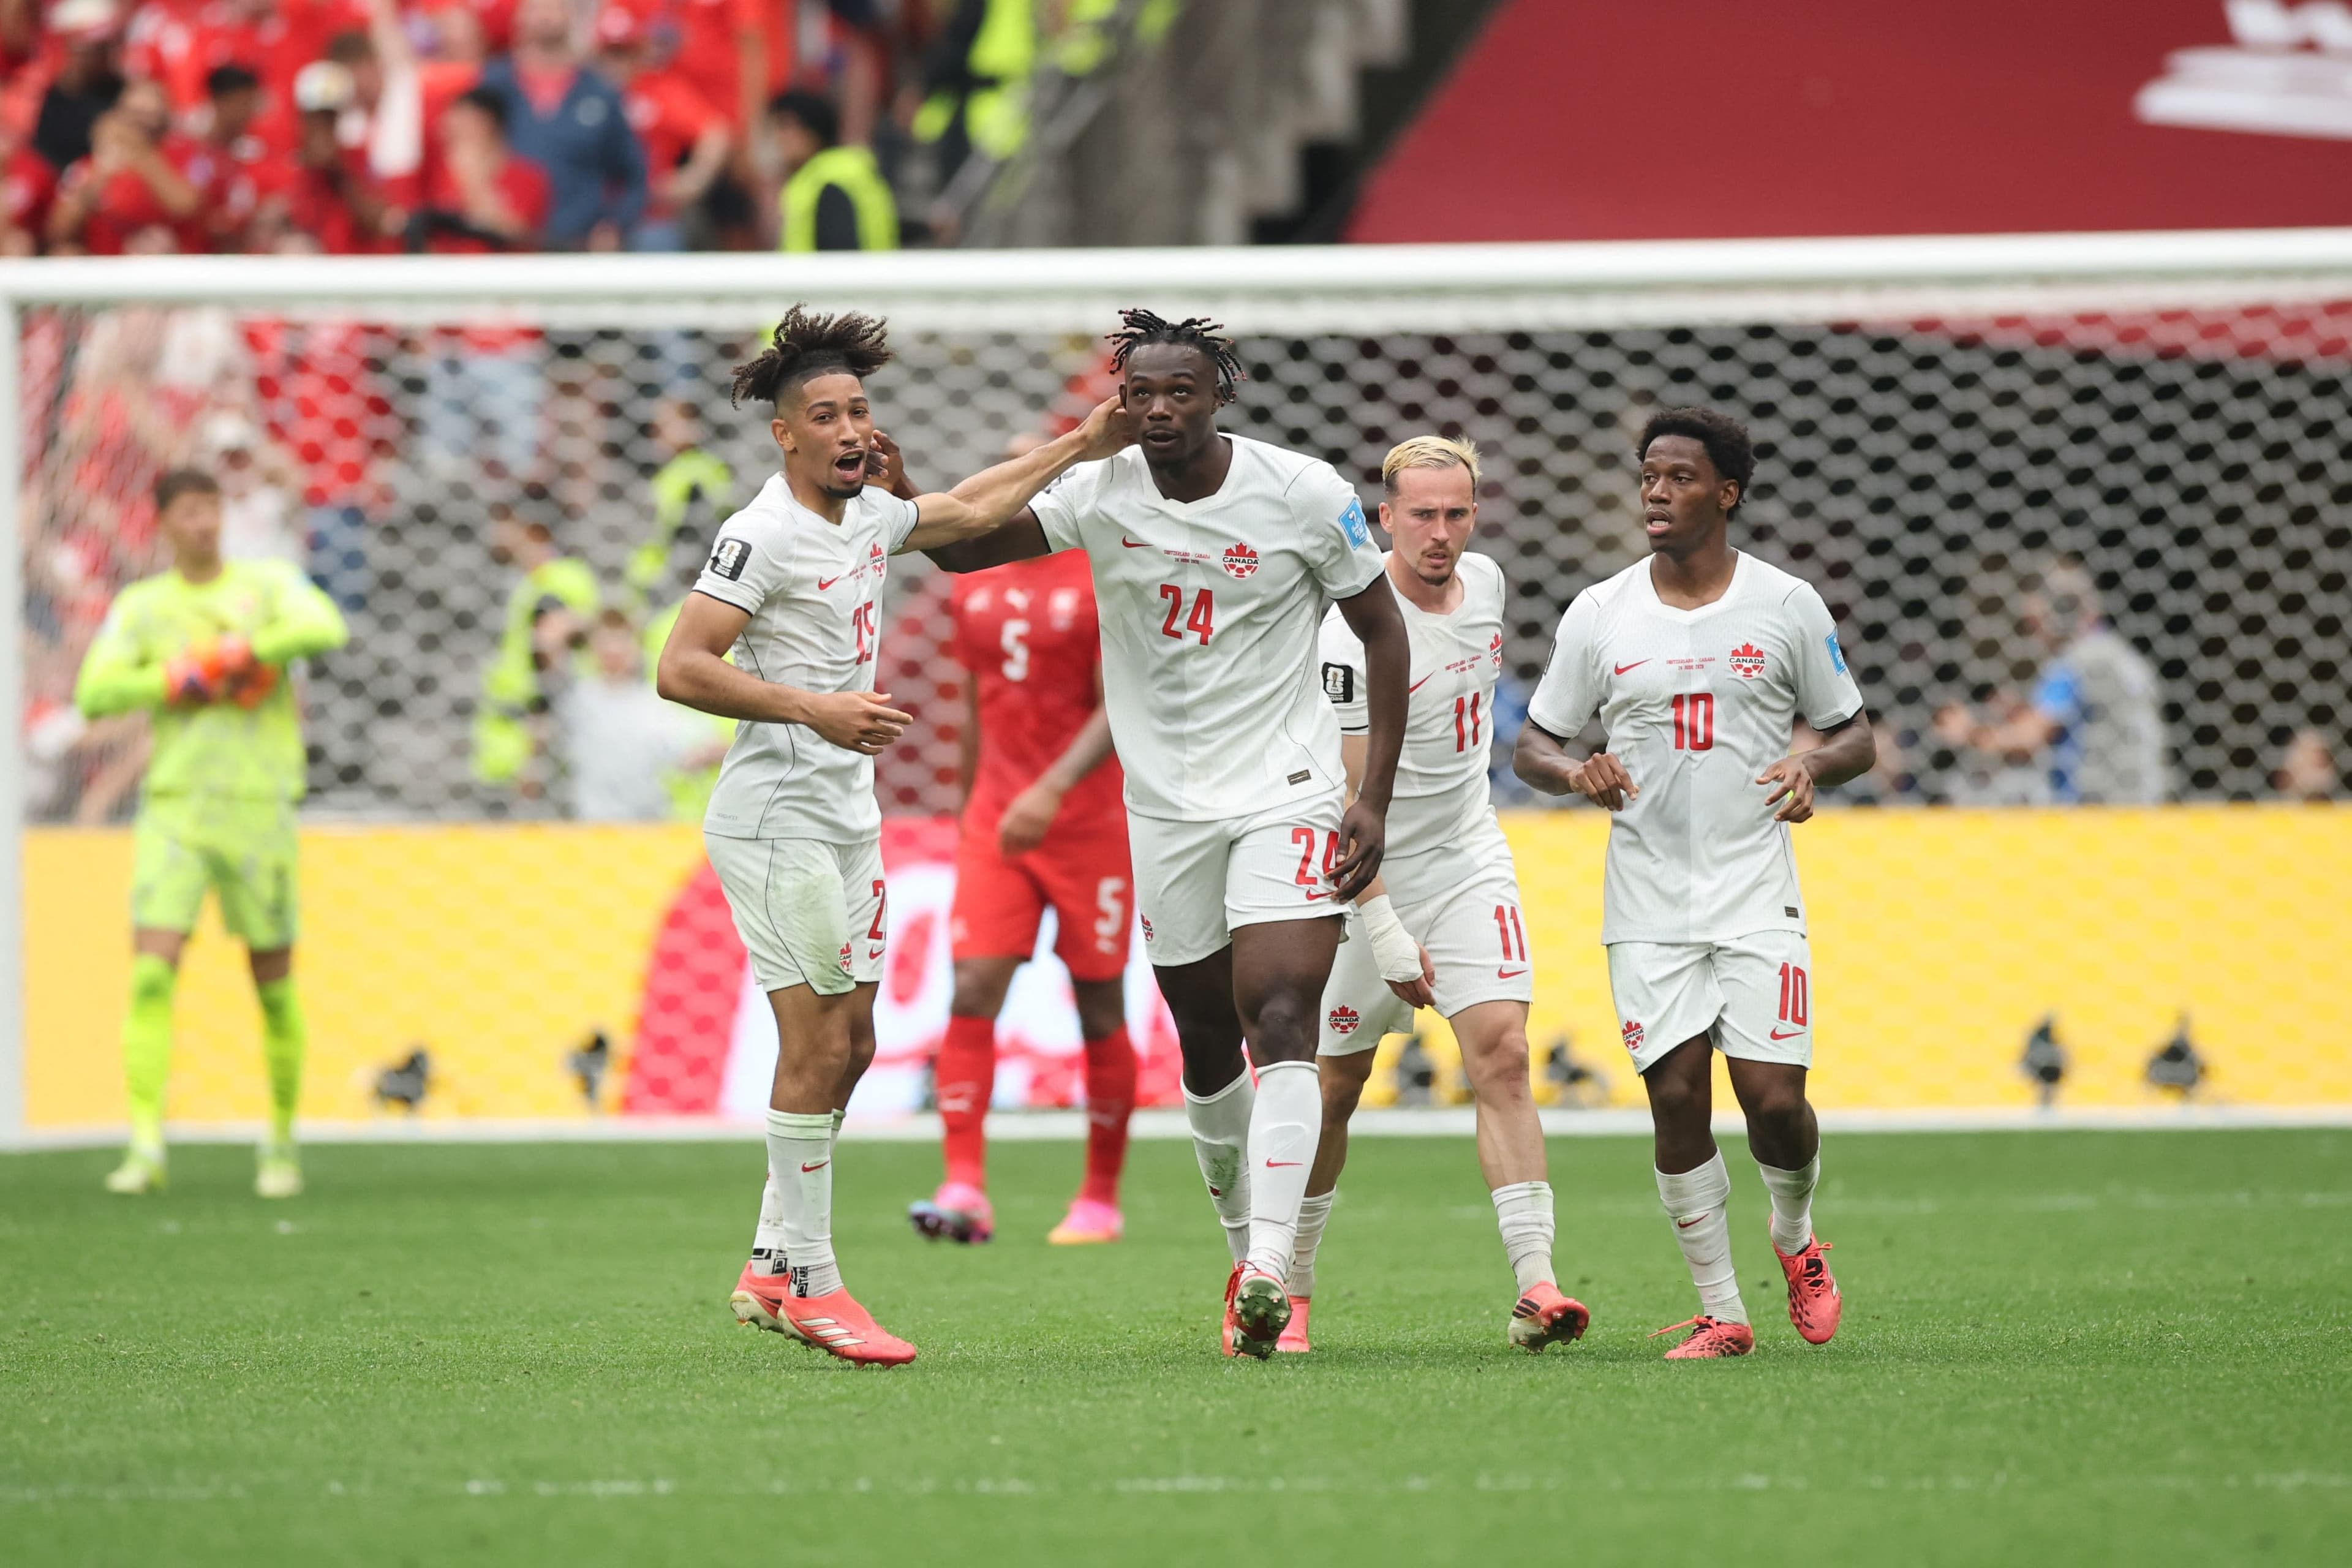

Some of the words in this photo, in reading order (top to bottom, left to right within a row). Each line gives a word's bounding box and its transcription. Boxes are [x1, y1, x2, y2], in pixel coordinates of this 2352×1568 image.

[1160, 584, 1213, 646] 24
[1000, 618, 1031, 682] 5
[1455, 692, 1480, 753] 11
[1671, 693, 1713, 751] 10
[867, 880, 887, 940] 2
[1095, 876, 1126, 937] 5
[1494, 905, 1526, 962] 11
[1779, 962, 1807, 1027] 10
[1623, 1029, 1644, 1041] CANADA
